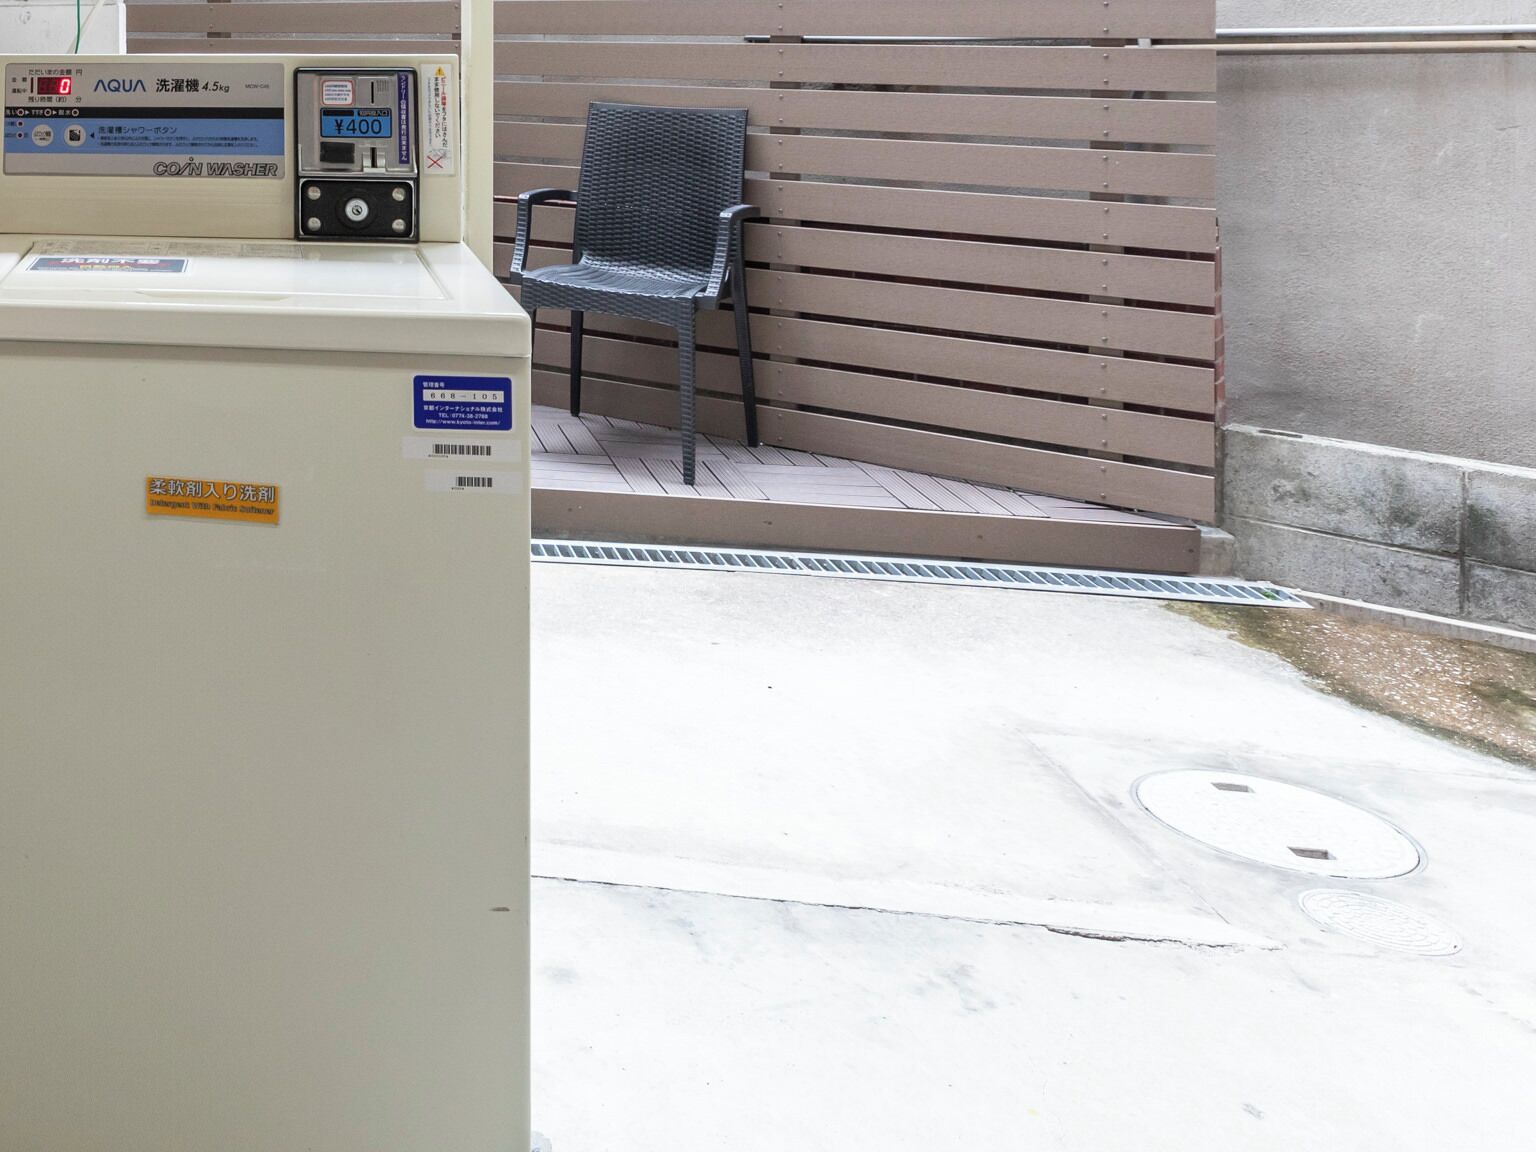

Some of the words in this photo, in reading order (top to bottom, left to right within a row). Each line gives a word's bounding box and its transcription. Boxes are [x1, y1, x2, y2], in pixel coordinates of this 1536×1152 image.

[59, 79, 71, 94] 0
[93, 78, 147, 93] AQUA
[155, 78, 200, 93] 洗濯機
[201, 81, 230, 93] 4.5kg
[98, 125, 178, 135] 洗濯槽シャワーボタン
[334, 118, 382, 135] ¥400
[153, 156, 203, 176] COIN
[207, 162, 279, 177] WASHER
[150, 479, 275, 503] 柔軟剤入り洗剤
